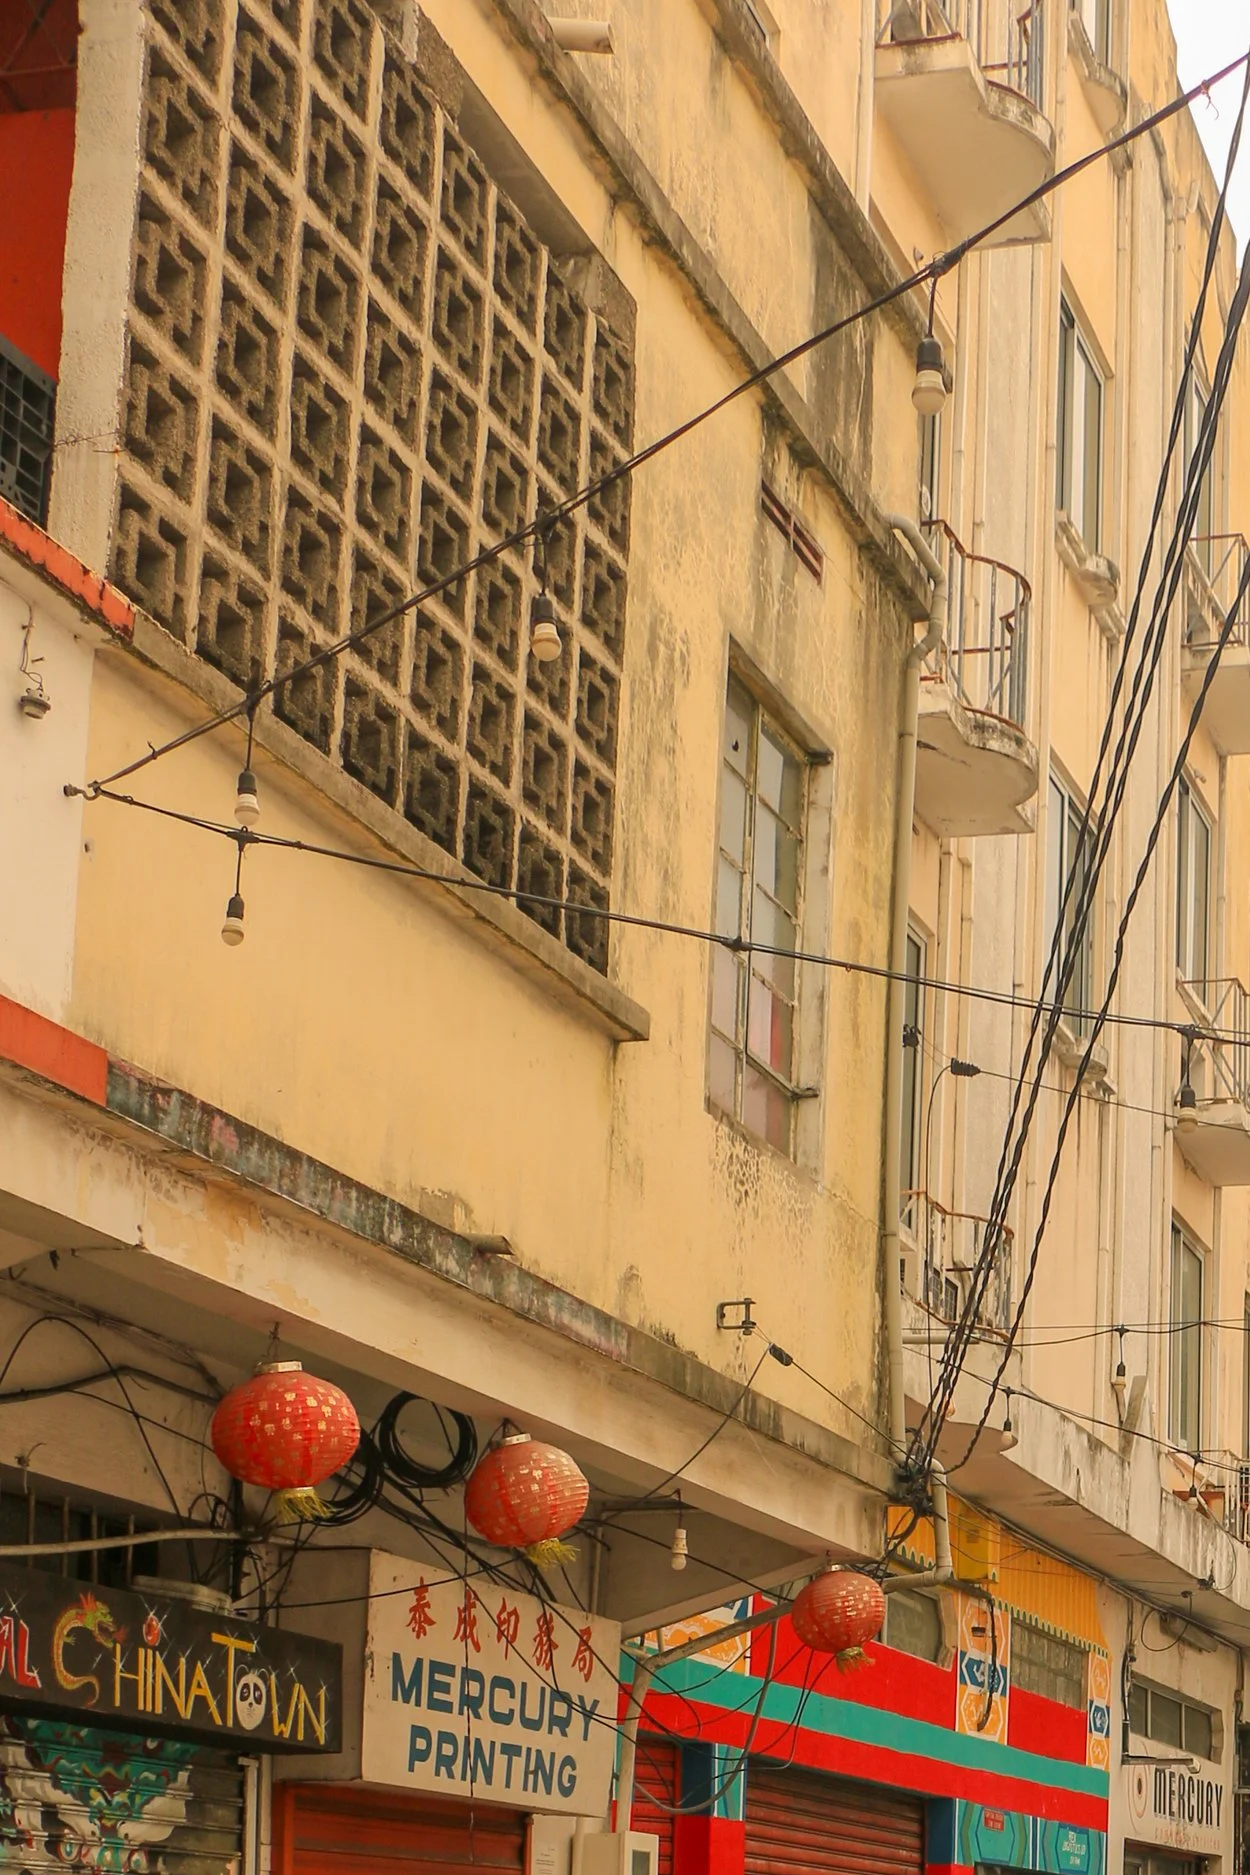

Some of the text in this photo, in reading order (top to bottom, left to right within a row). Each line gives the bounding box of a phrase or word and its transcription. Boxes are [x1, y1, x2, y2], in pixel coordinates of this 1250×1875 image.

[391, 1652, 600, 1742] MERCURY
[408, 1724, 577, 1798] PRINTING
[1154, 1767, 1223, 1828] MERCURY
